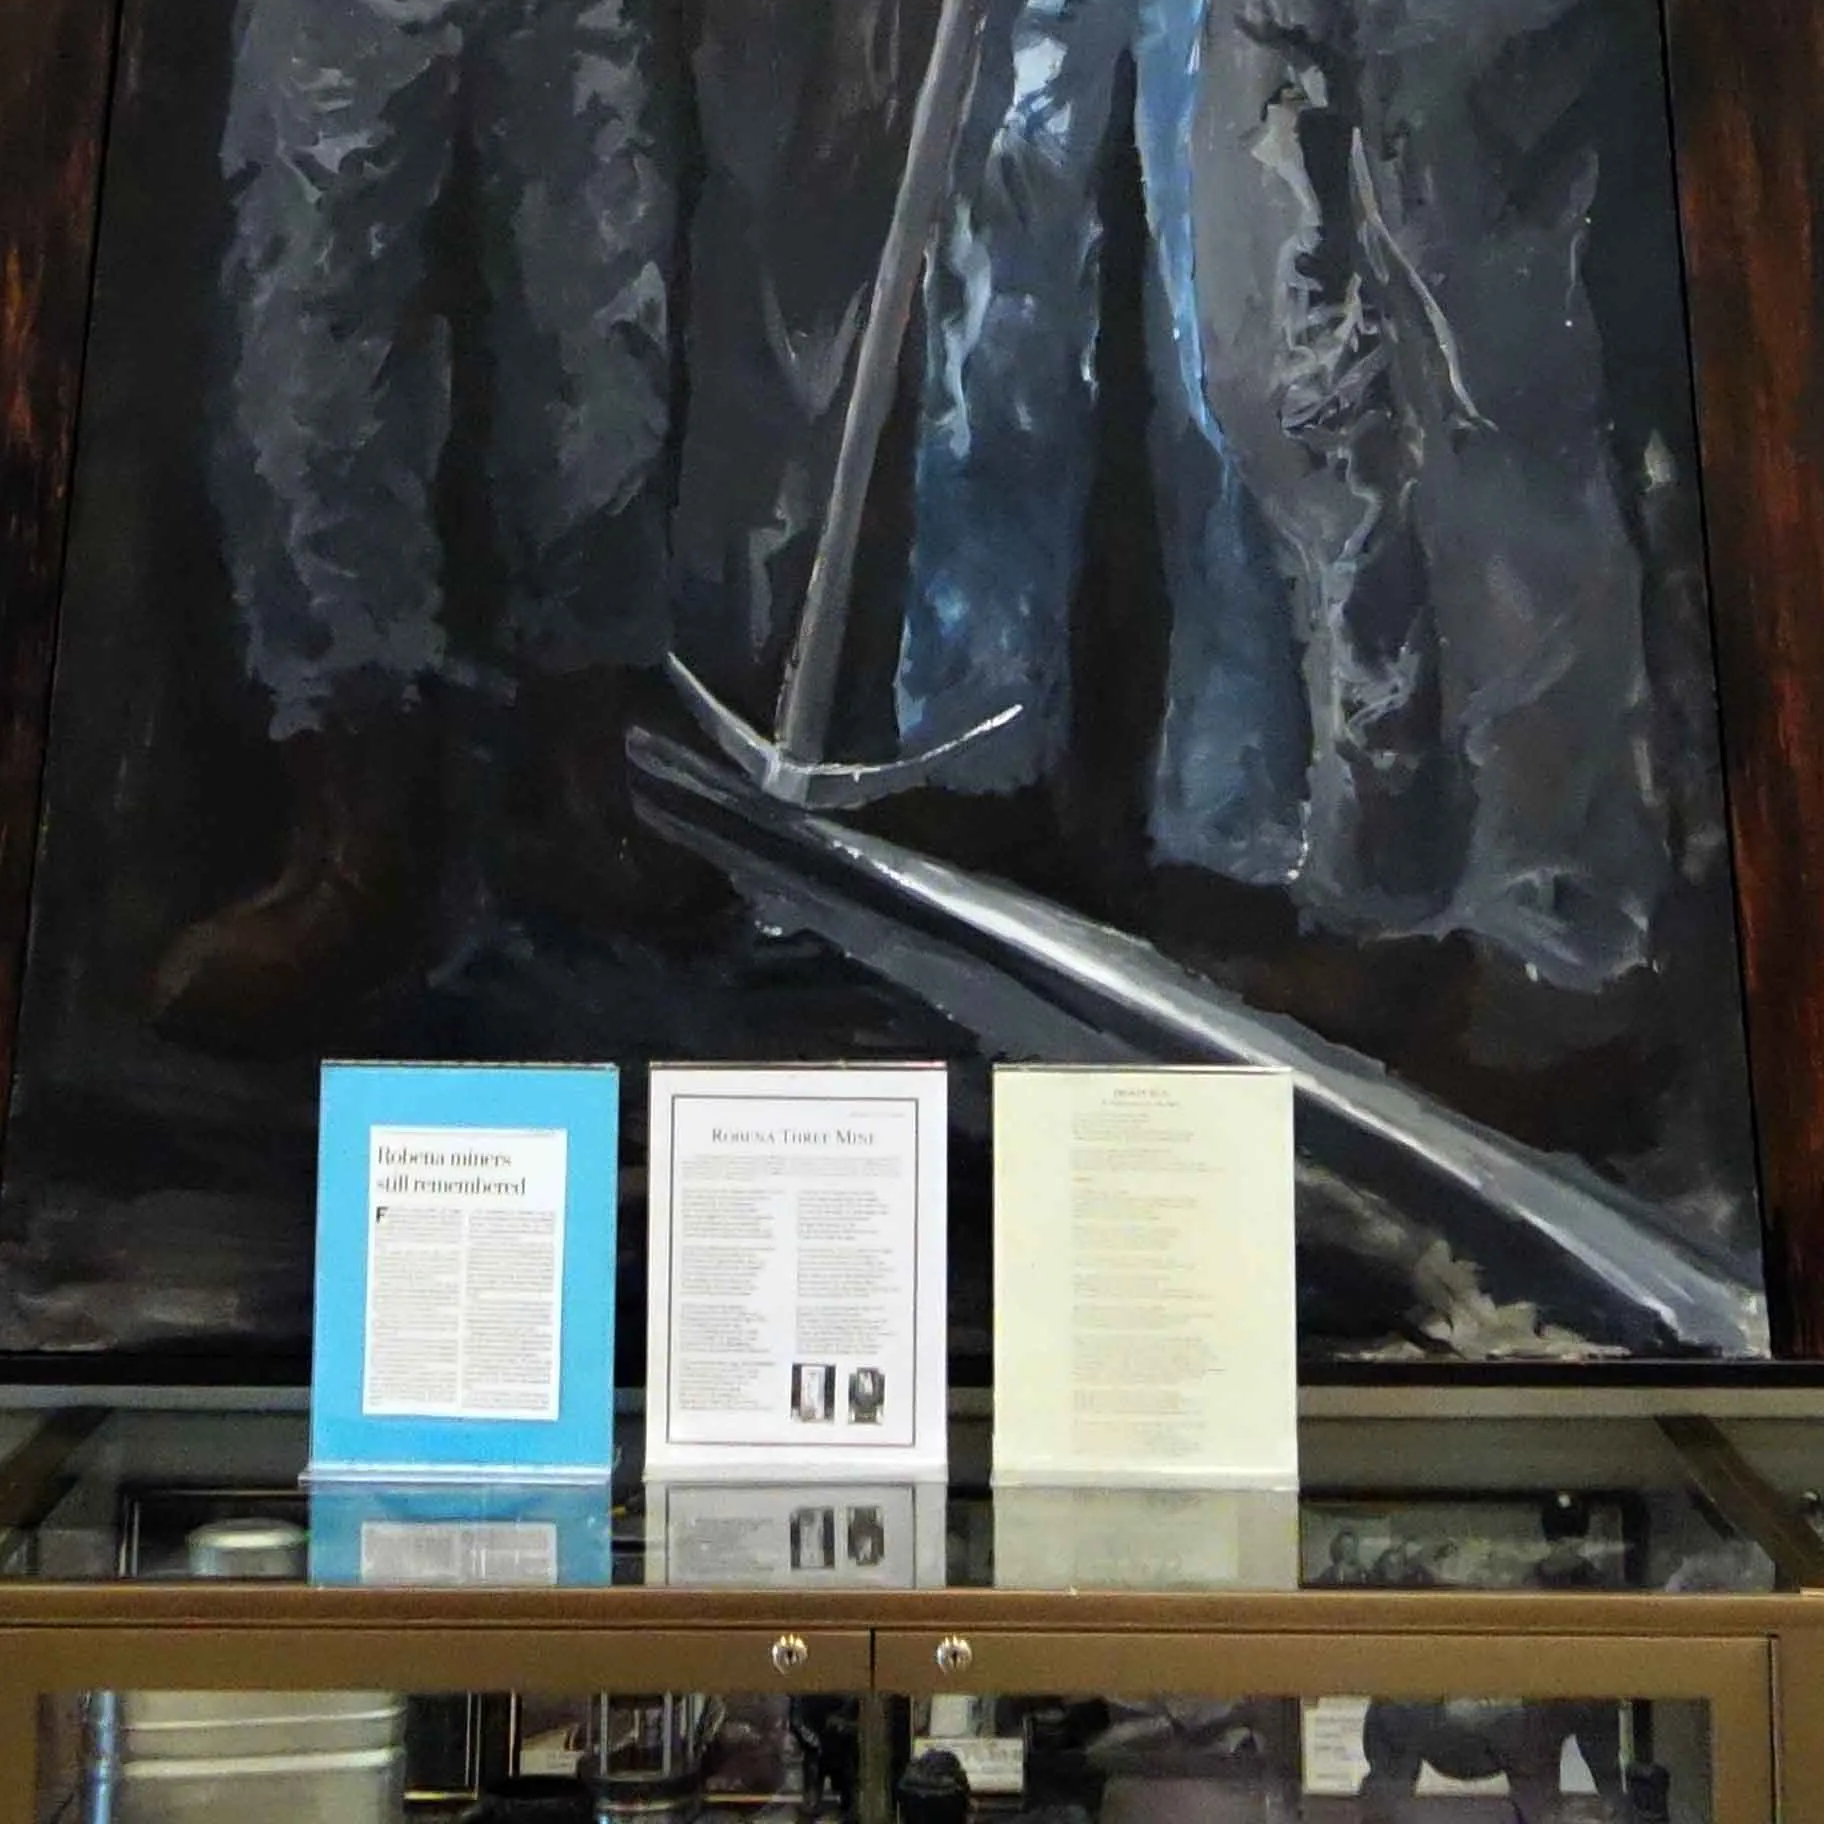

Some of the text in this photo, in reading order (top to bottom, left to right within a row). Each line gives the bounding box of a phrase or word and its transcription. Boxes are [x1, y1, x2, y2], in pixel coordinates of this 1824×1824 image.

[377, 1145, 513, 1168] Robena miners
[375, 1175, 527, 1196] still remembered
